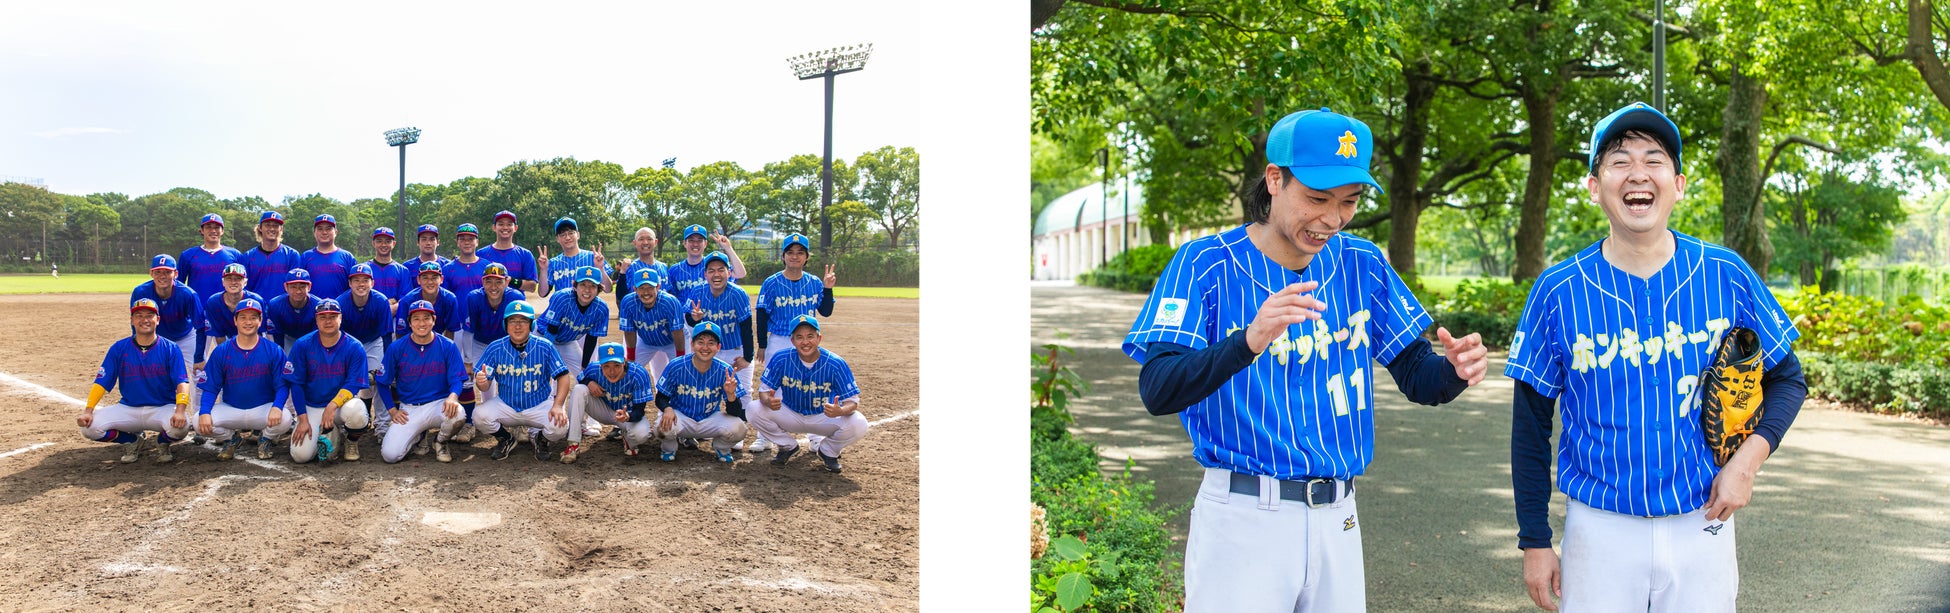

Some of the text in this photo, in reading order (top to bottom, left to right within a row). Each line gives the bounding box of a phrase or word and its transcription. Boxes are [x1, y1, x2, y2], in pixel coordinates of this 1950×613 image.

[1335, 130, 1357, 159] ホ
[722, 322, 736, 334] 17
[523, 380, 538, 393] 31
[781, 375, 832, 394] ホンキッキーズ
[1326, 368, 1367, 417] 11
[1677, 375, 1703, 418] 2
